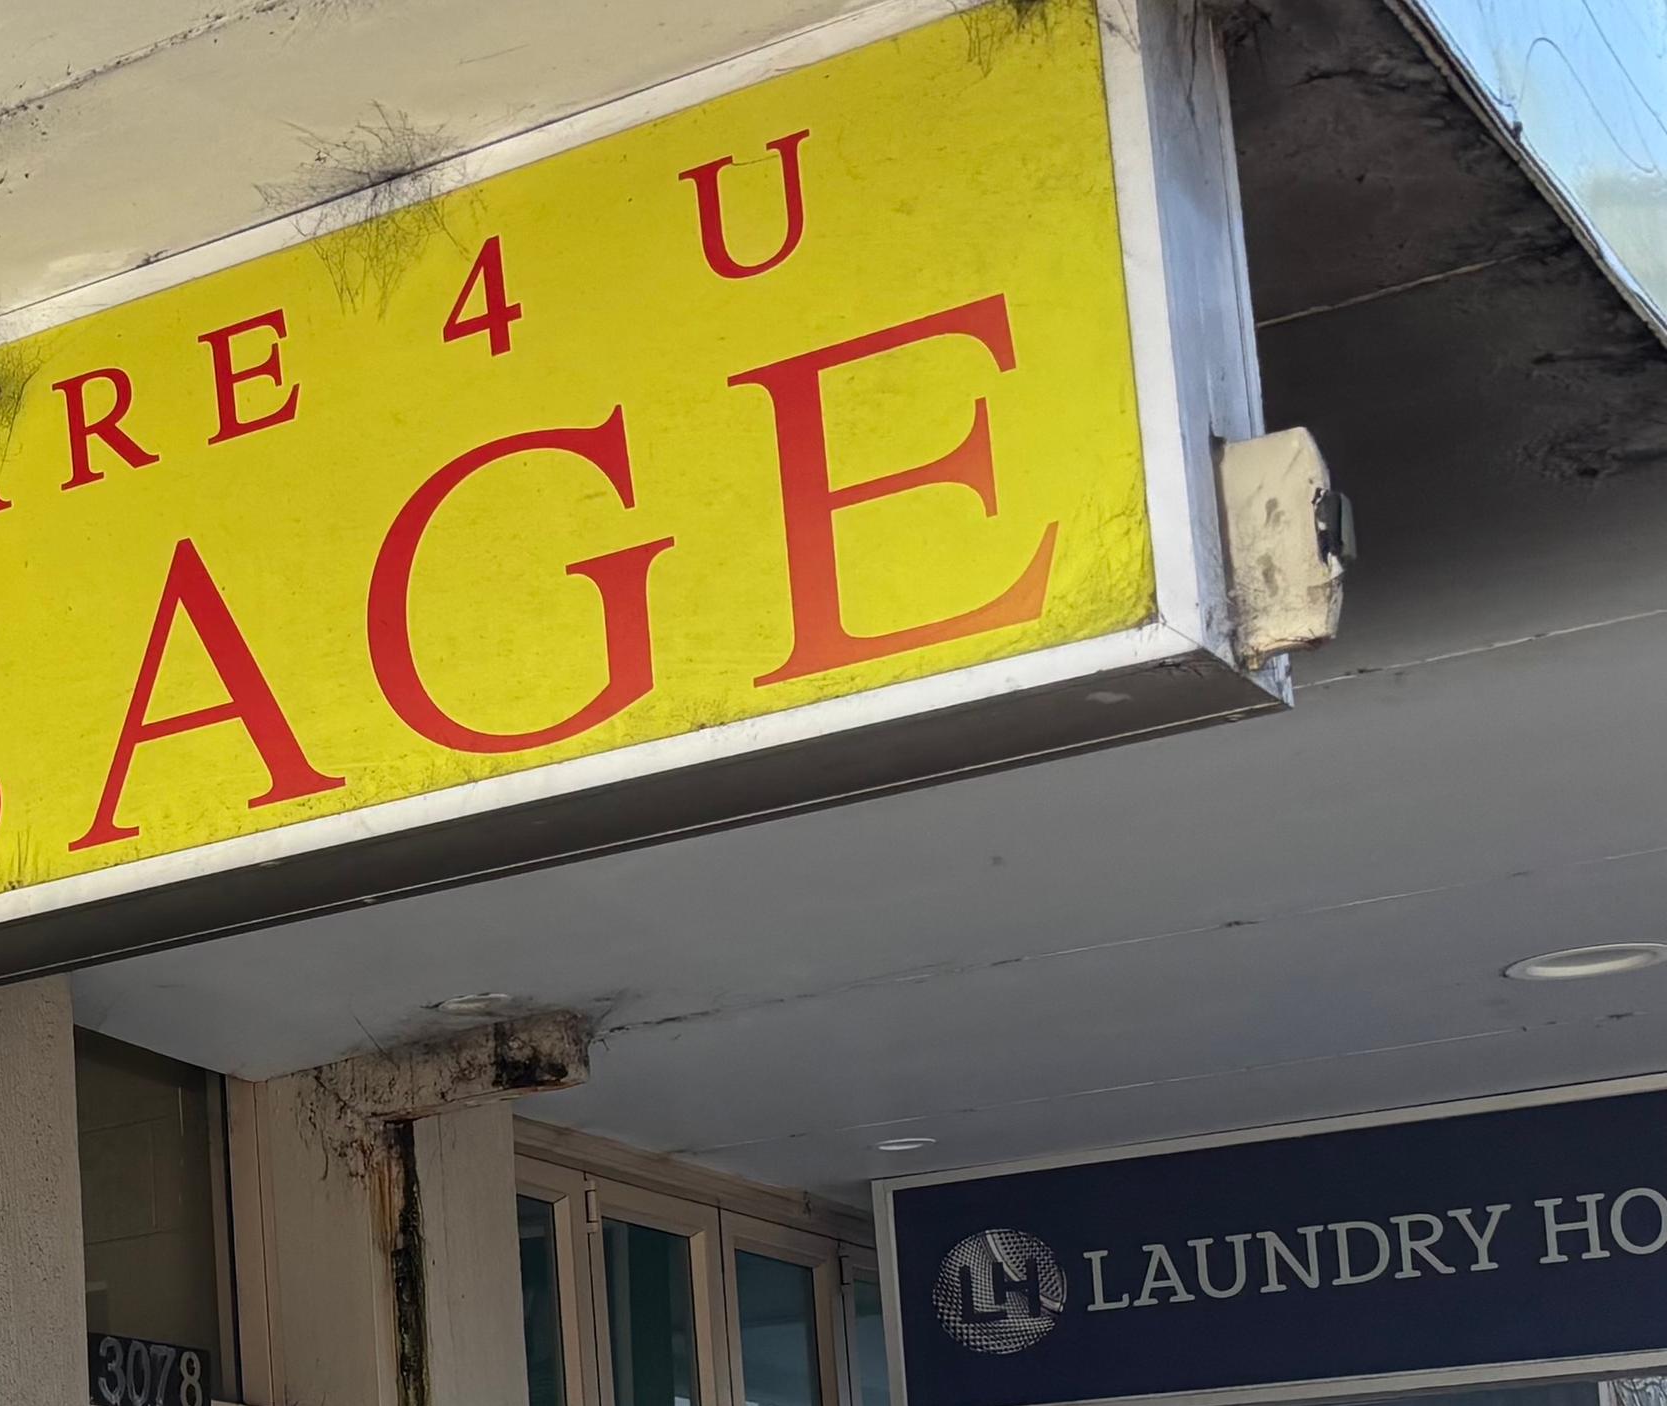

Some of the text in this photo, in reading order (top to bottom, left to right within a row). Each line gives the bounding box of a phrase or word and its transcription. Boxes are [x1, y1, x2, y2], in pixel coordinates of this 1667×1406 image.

[441, 235, 524, 358] 4
[680, 130, 809, 281] U
[1082, 1187, 1667, 1312] LAUNDRY HO
